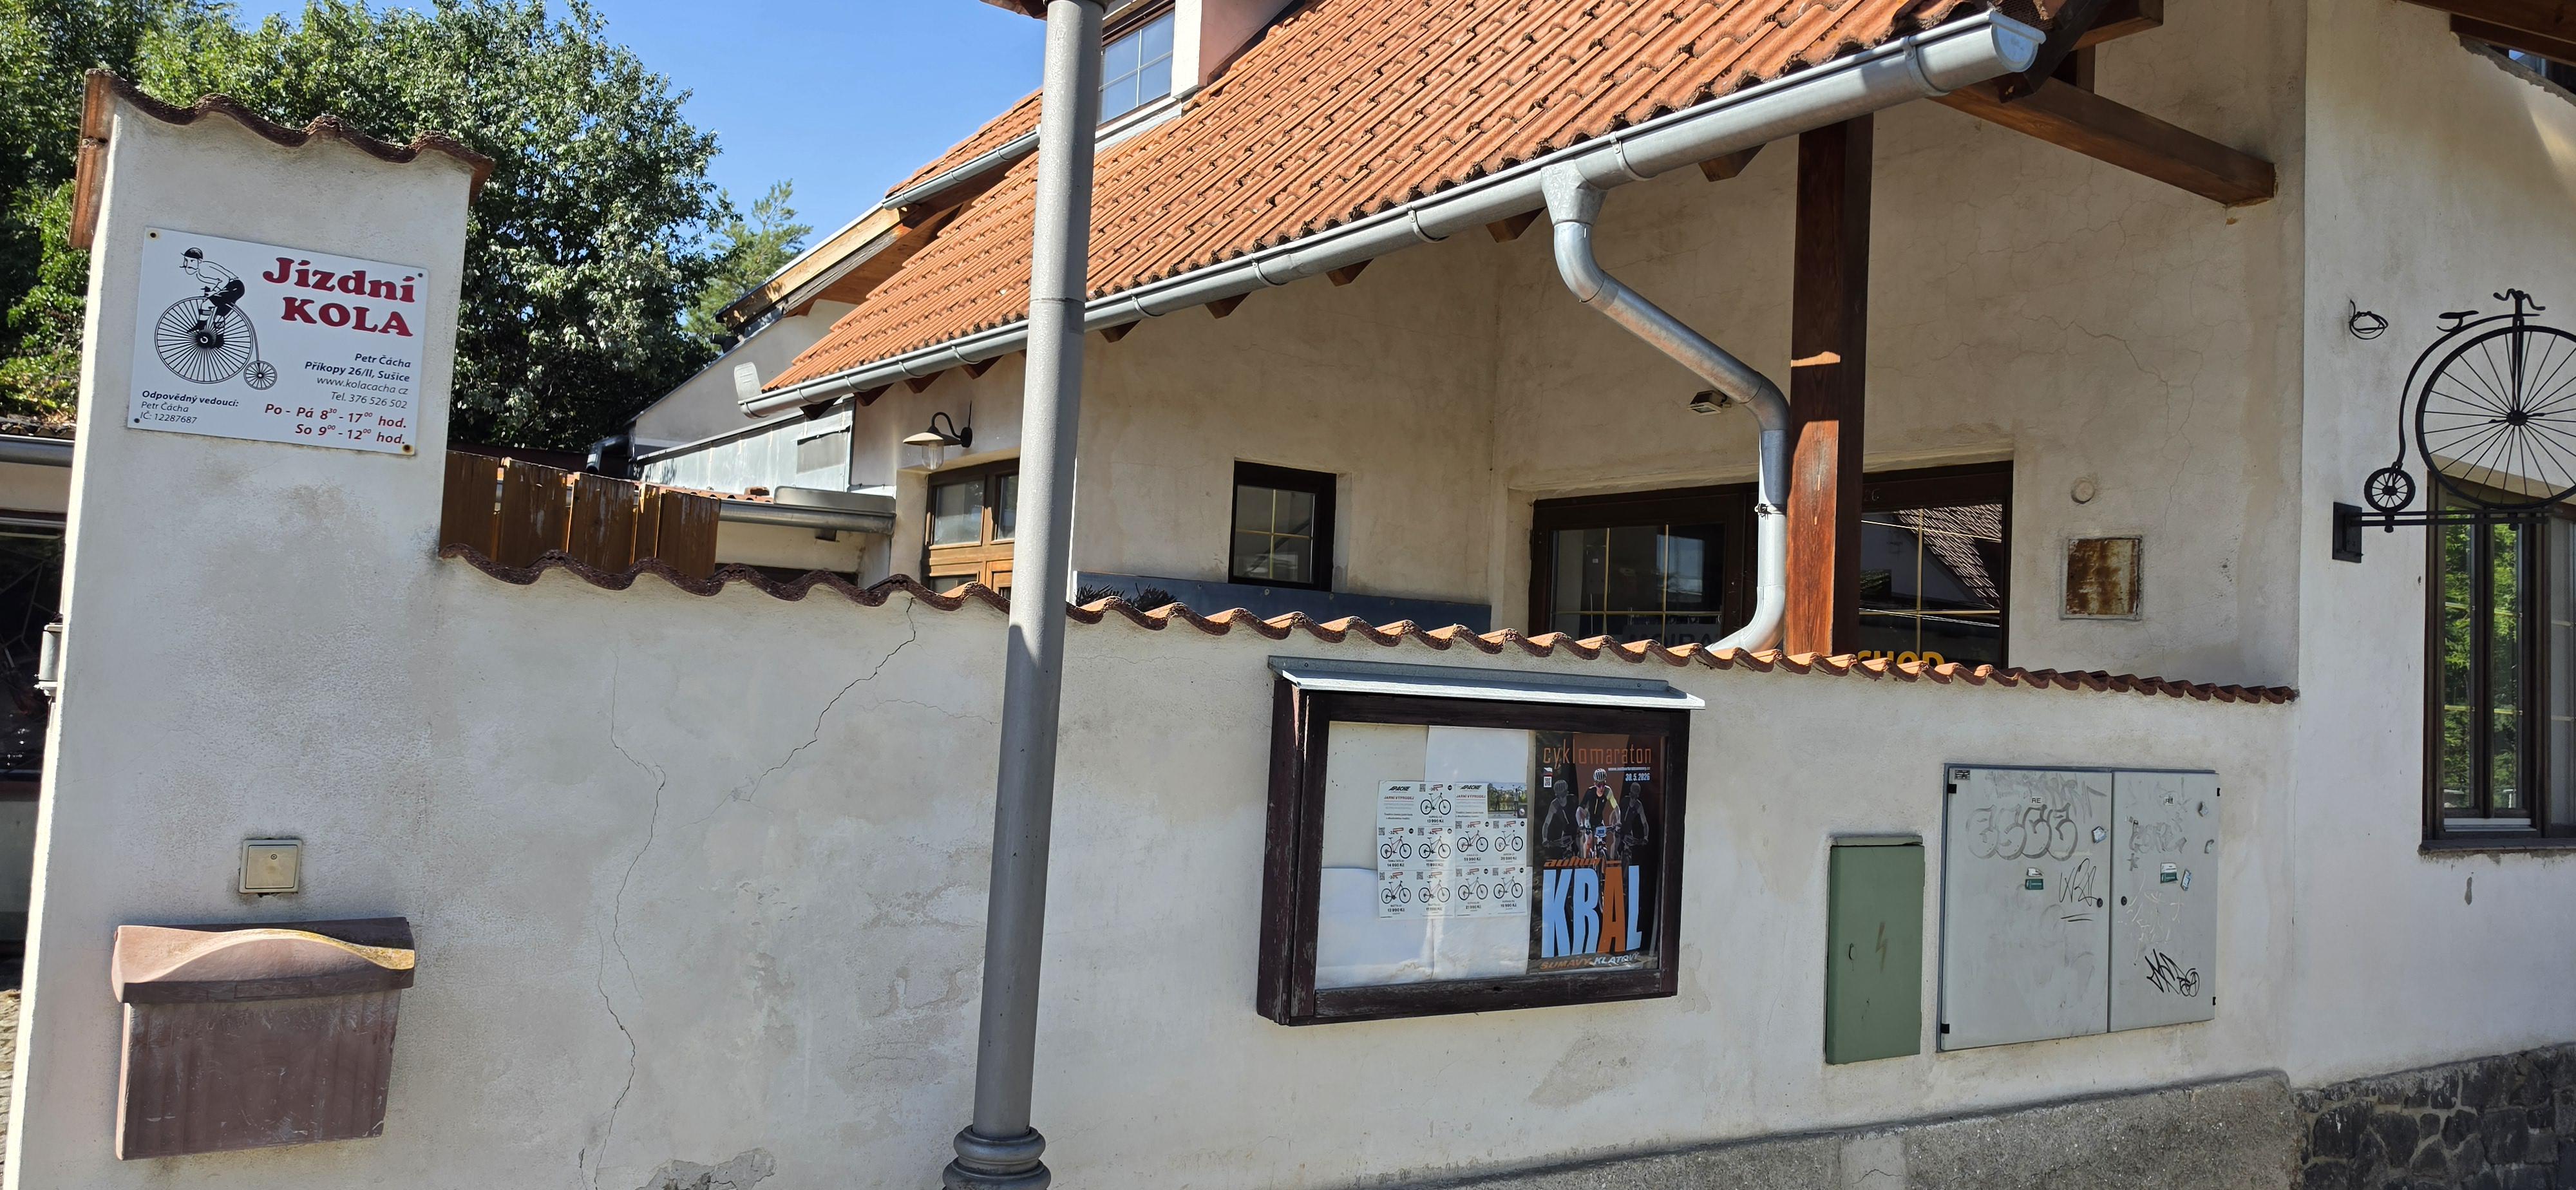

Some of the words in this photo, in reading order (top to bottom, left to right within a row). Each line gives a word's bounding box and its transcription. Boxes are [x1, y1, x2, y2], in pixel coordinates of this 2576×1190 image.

[263, 257, 415, 303] Jízdní
[281, 297, 413, 337] KOLA
[355, 353, 377, 363] Petr
[379, 355, 411, 368] Čácha
[305, 361, 346, 375] Příkopy
[348, 367, 375, 379] 26/II,
[377, 370, 410, 382] Sušice
[317, 377, 408, 395] www.kolacachacz
[141, 401, 159, 410] Petr
[161, 402, 189, 412] Čácha
[142, 390, 198, 404] Odpovědný
[200, 397, 239, 407] vedoucí:
[331, 392, 346, 401] Tel.
[348, 394, 367, 404] 376
[369, 396, 388, 406] 526
[389, 399, 408, 409] 502
[140, 411, 152, 419] IČ:
[155, 413, 197, 424] 12287687
[265, 403, 282, 415] Po
[296, 407, 314, 418] Pá
[378, 416, 406, 428] hod.
[296, 424, 312, 435] So
[376, 432, 405, 444] hod.
[1543, 739, 1652, 769] cyklomaraton
